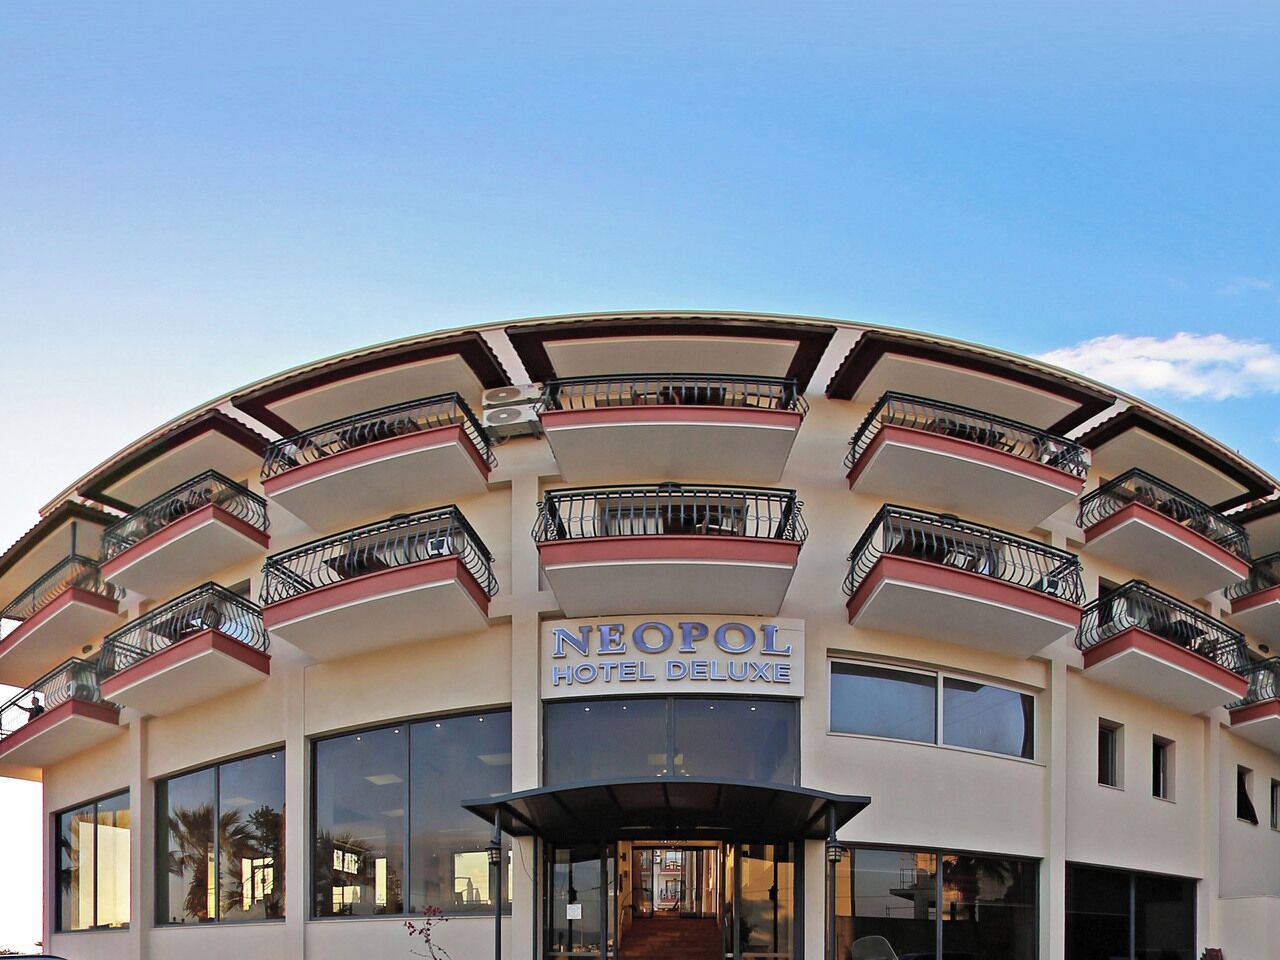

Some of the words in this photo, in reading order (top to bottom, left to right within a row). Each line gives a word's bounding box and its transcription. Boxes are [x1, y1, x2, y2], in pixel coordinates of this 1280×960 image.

[552, 621, 792, 658] NEOPOL
[552, 661, 656, 685] HOTEL
[666, 659, 792, 683] DELUXE
